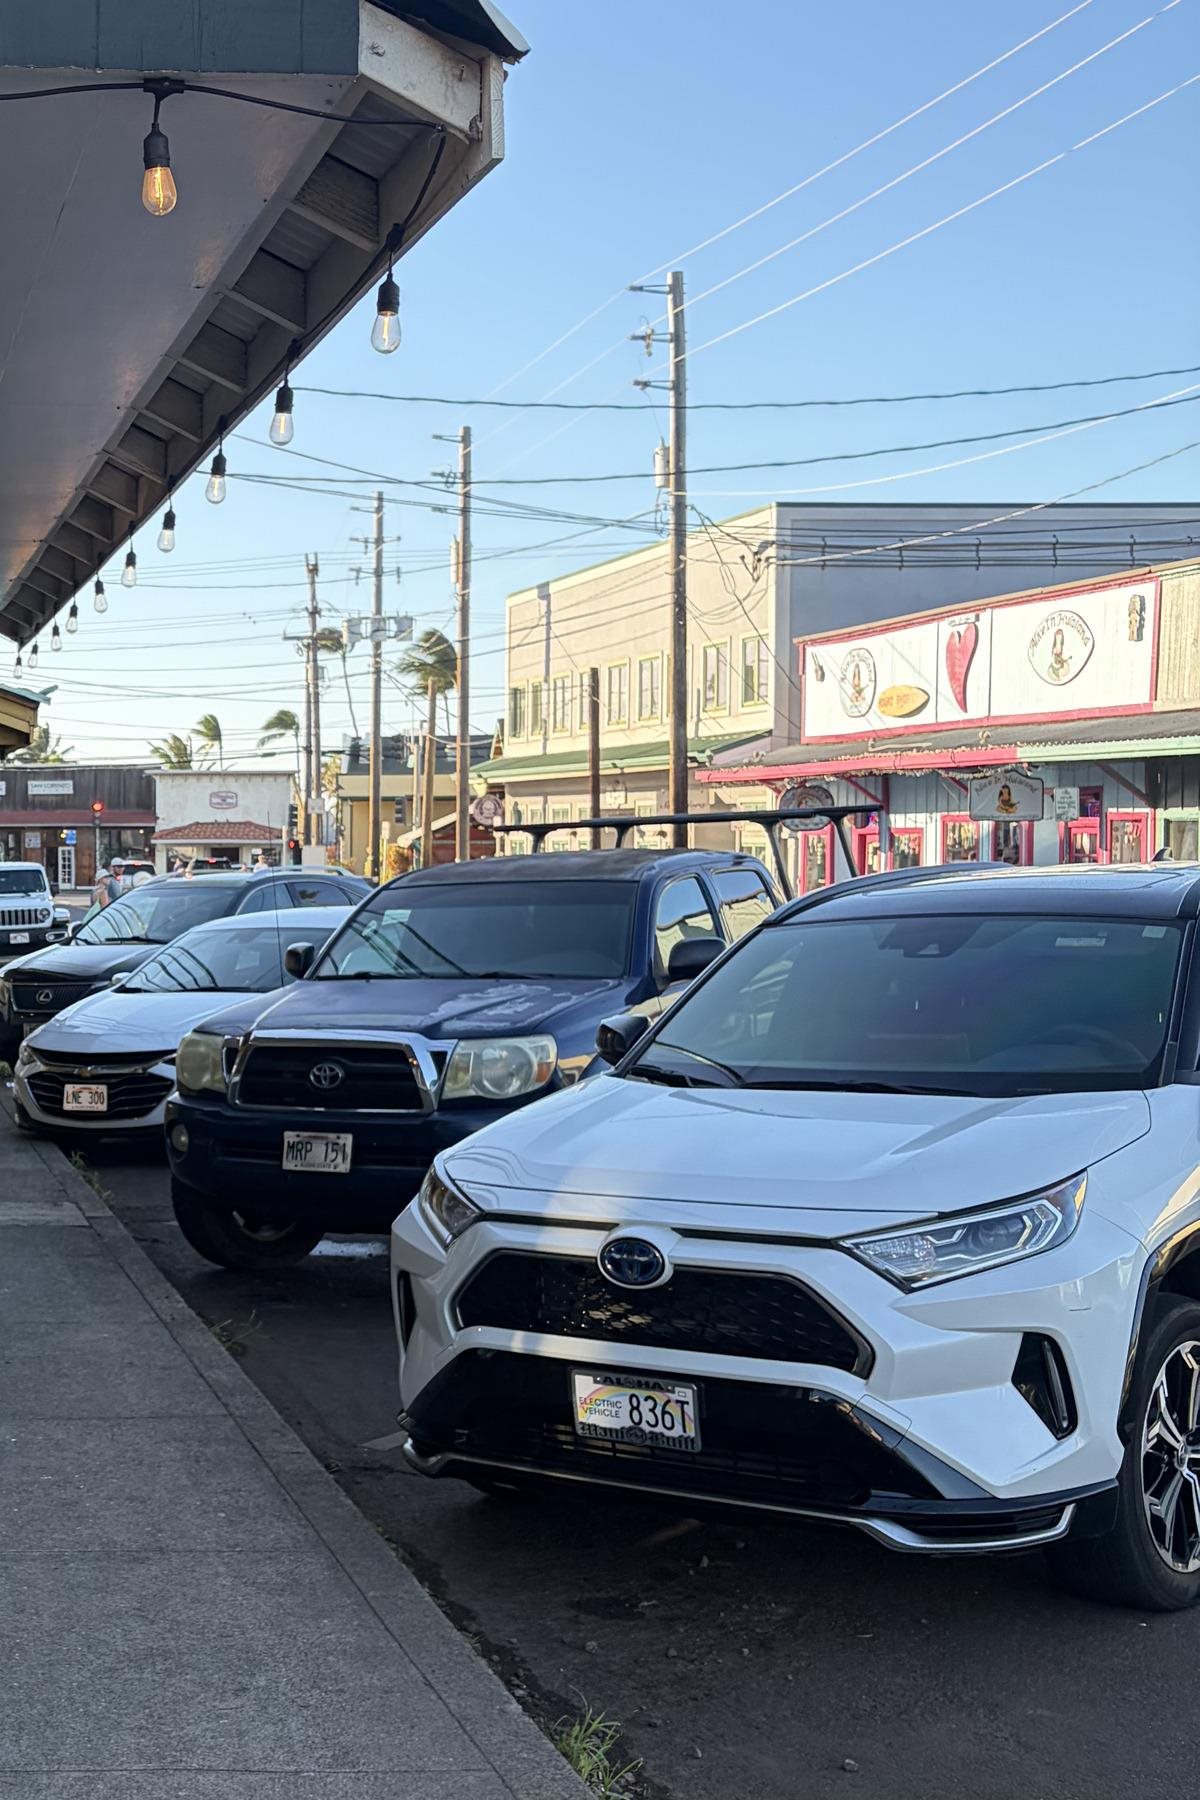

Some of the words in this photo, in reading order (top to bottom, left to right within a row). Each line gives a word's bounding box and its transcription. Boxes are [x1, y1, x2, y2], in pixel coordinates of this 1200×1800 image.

[286, 1140, 313, 1162] MRP
[324, 1141, 347, 1164] 151
[579, 1396, 623, 1410] ELECTRIC
[582, 1406, 621, 1419] VEHICLE
[628, 1393, 690, 1434] 836T
